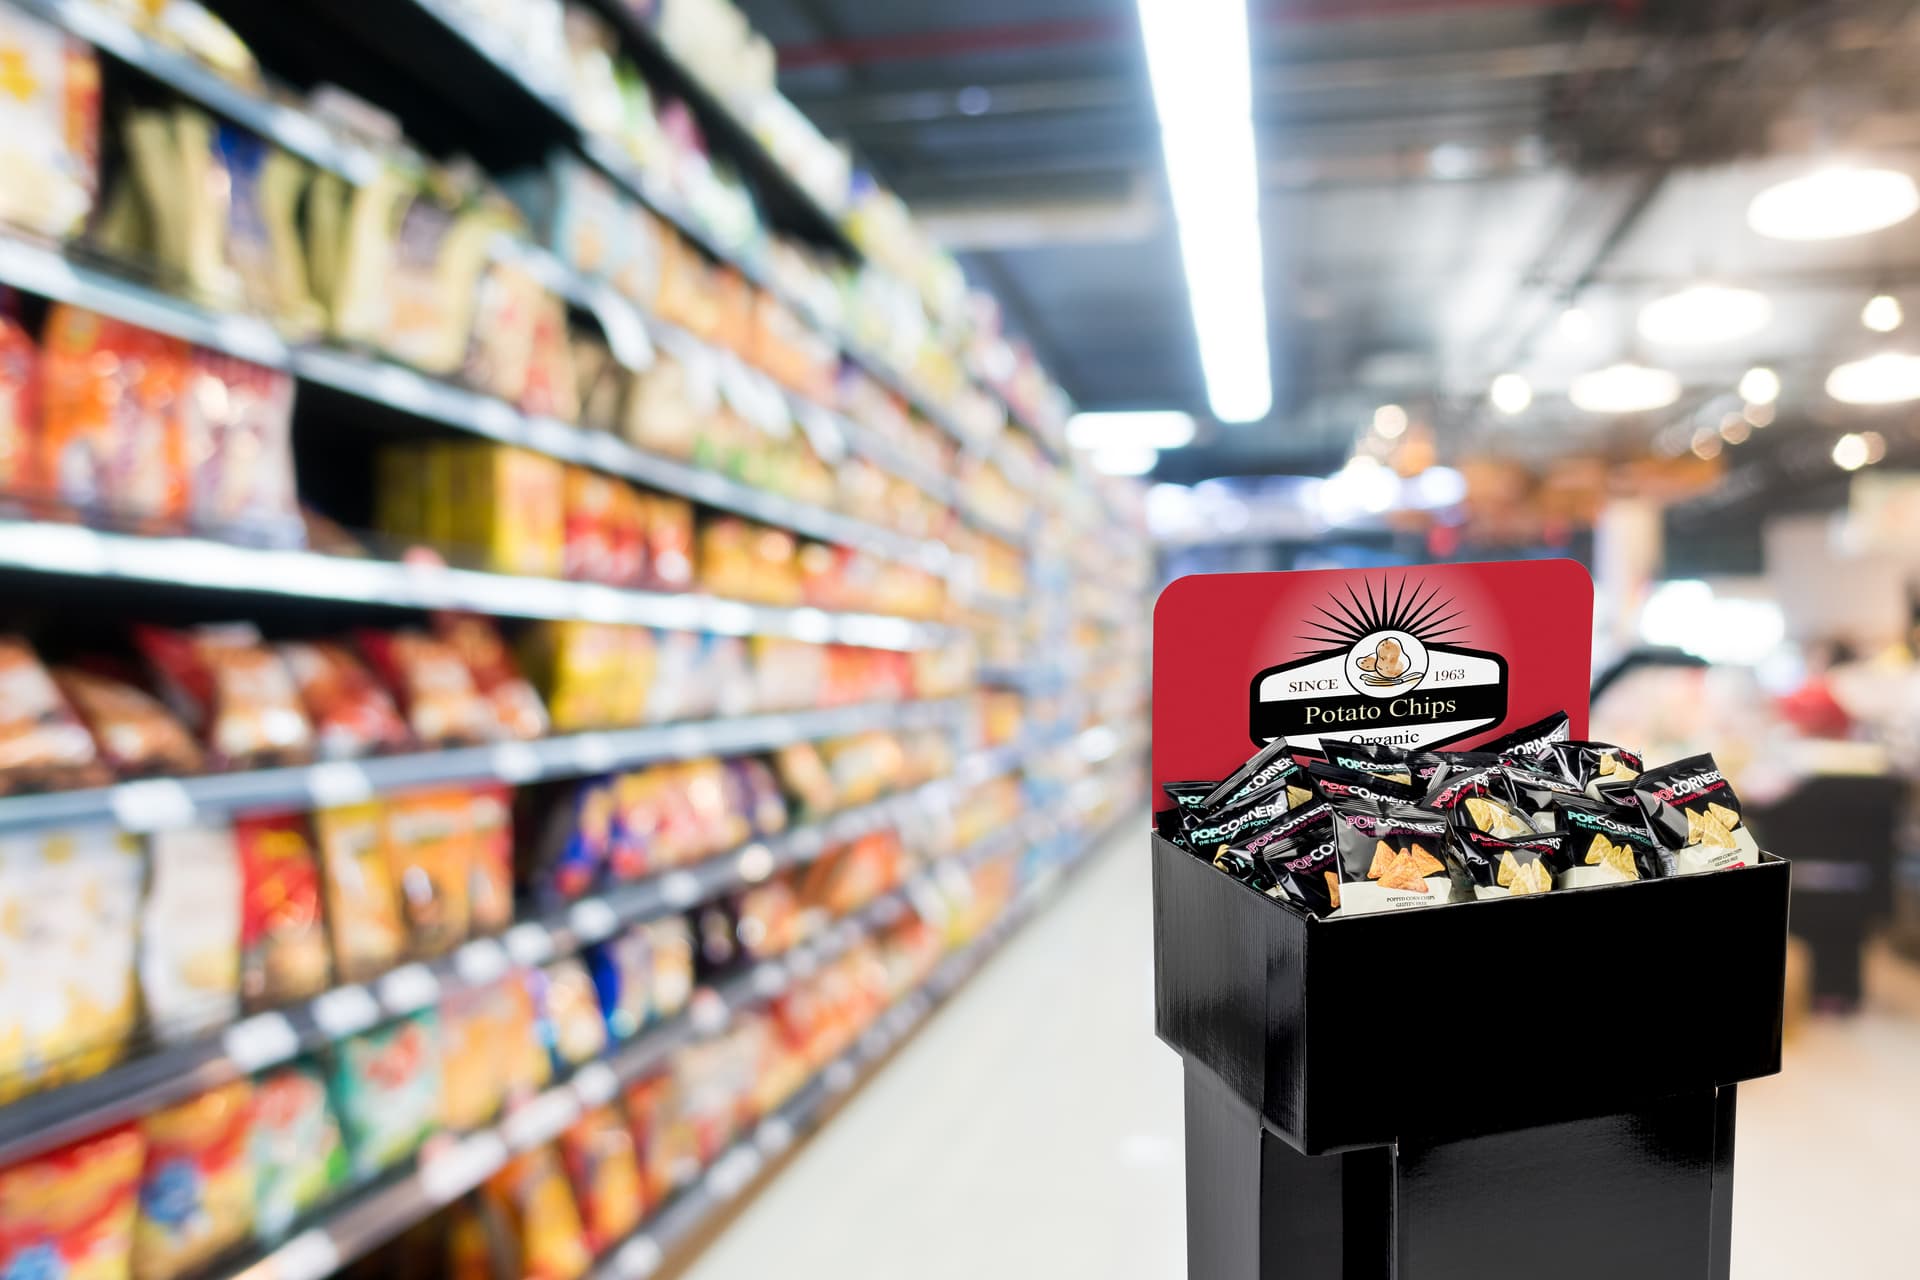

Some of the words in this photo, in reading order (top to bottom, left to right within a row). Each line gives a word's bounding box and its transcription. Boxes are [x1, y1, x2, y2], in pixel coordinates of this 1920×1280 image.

[1288, 678, 1338, 693] SINCE
[1434, 668, 1465, 682] 1963
[1304, 705, 1381, 725] Potato
[1389, 696, 1457, 720] Chips
[1190, 803, 1284, 843] POPCORNERS
[1345, 815, 1445, 834] POPCORNERS
